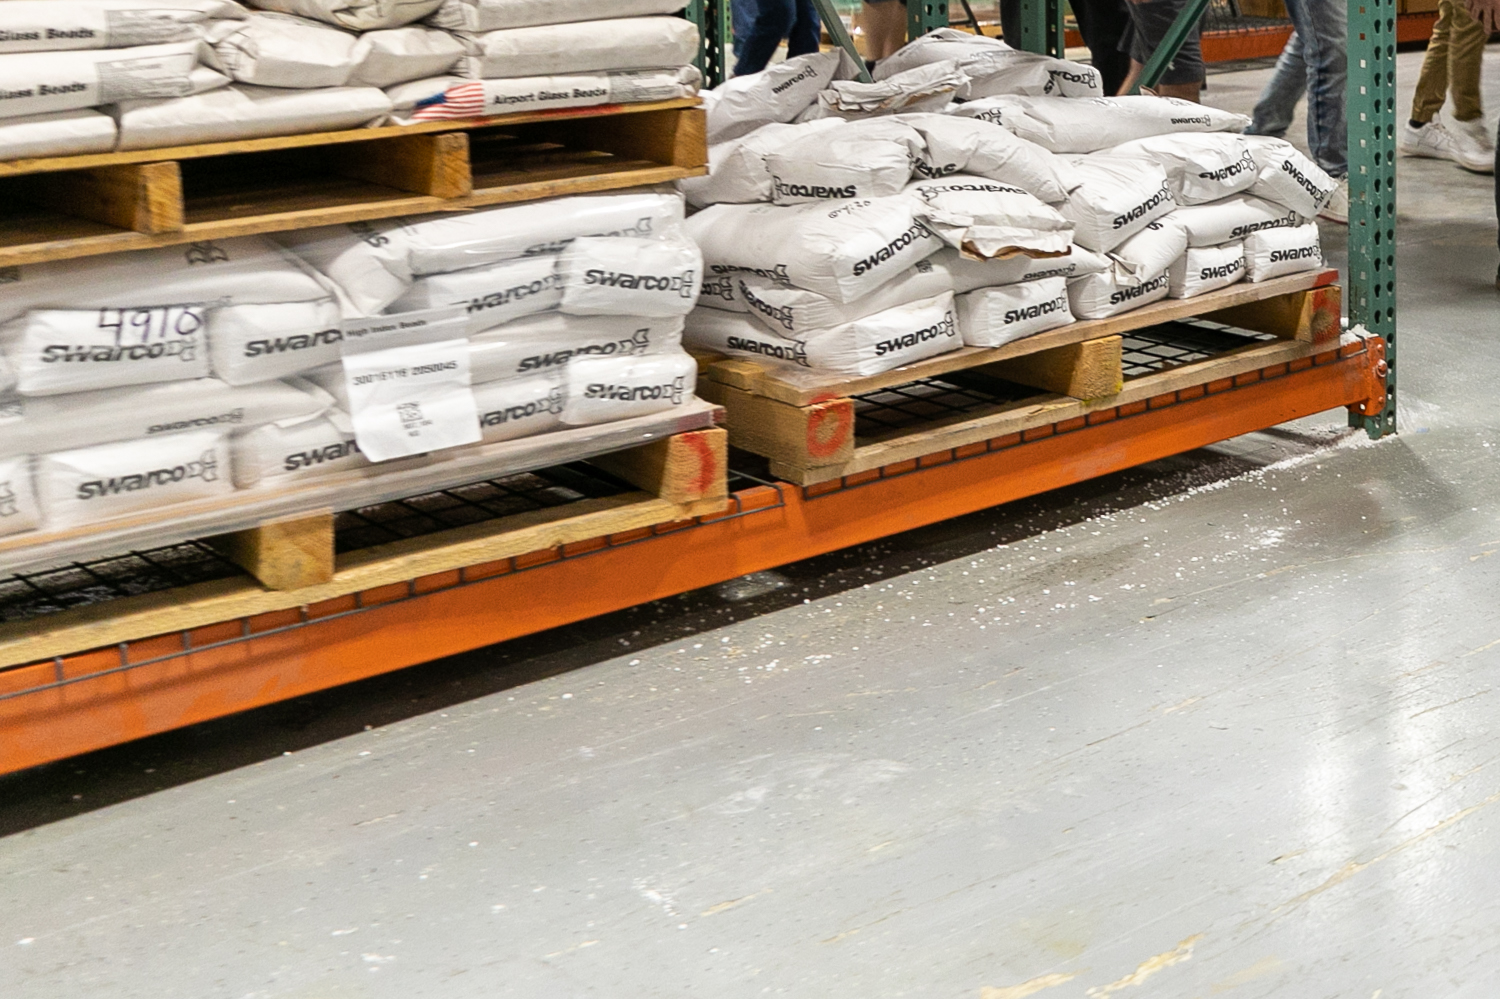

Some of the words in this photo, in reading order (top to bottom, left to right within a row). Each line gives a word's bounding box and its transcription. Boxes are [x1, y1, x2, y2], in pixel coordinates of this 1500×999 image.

[493, 92, 535, 106] Airport
[537, 89, 570, 101] Glass
[1282, 159, 1317, 197] swarco
[788, 184, 857, 200] swarco
[1113, 193, 1160, 230] swarco
[852, 228, 912, 277] swarco
[1269, 245, 1313, 263] swarco
[583, 268, 671, 292] swarco
[1199, 258, 1240, 281] swarco
[1109, 278, 1160, 306] swarco
[1003, 299, 1057, 325] swarco
[40, 342, 166, 363] swarco
[726, 336, 785, 360] swarco
[875, 325, 939, 357] swarco
[583, 383, 662, 401] swarco
[76, 464, 186, 501] swarco
